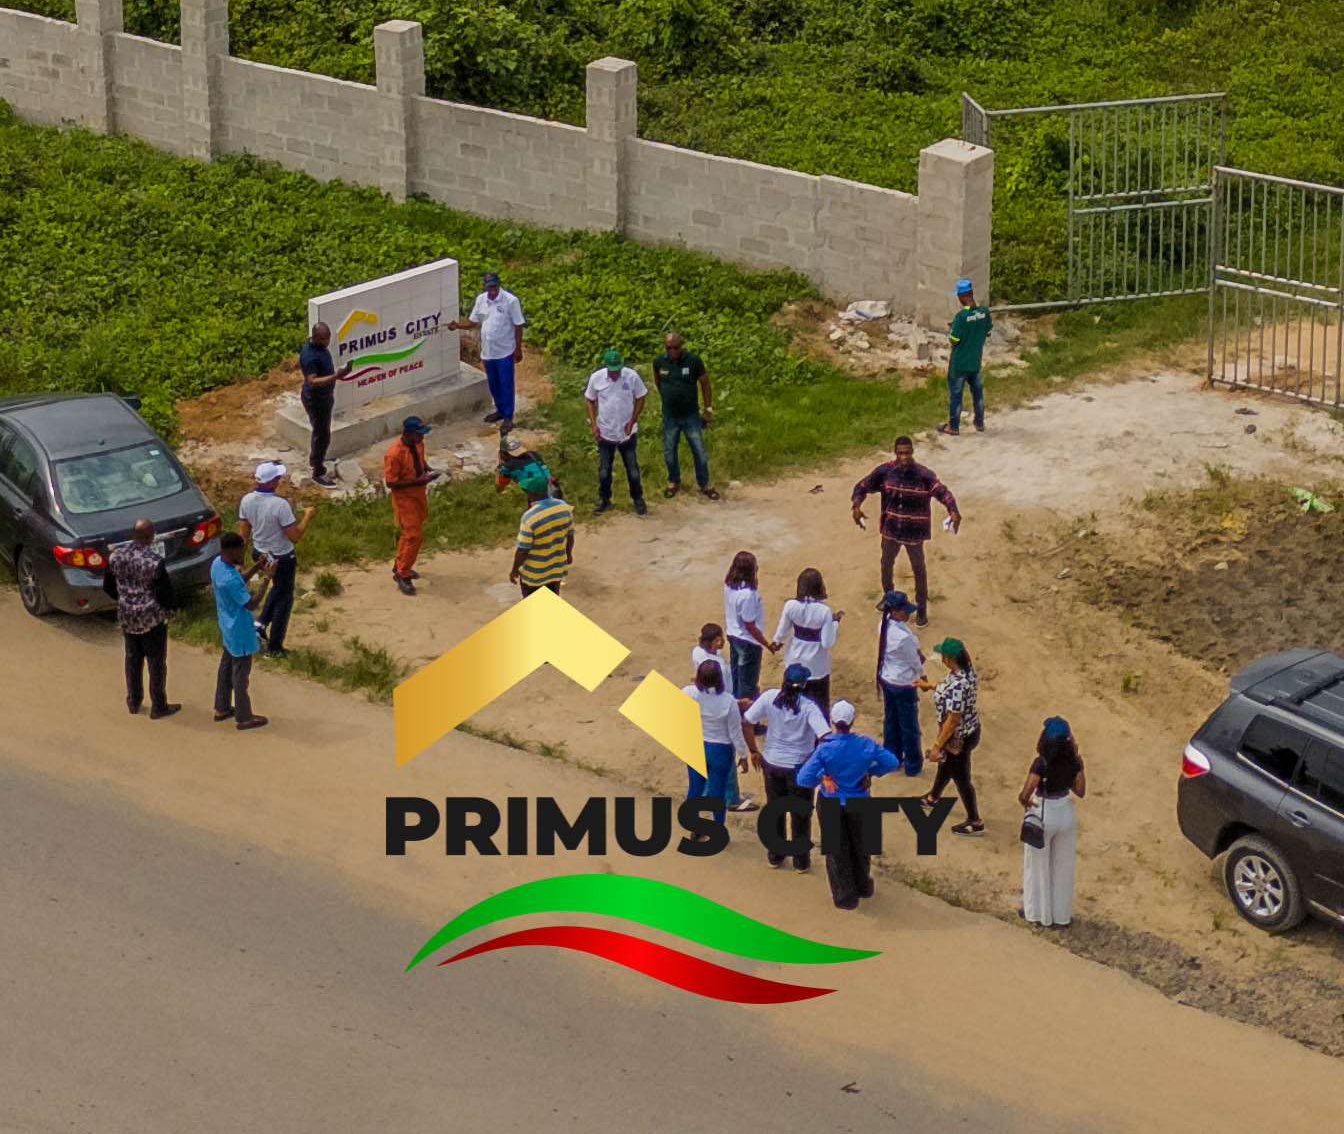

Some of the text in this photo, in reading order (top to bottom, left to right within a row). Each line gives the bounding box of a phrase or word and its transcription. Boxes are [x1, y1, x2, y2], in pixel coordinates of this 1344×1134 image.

[339, 312, 441, 356] PRIMUS CITY
[388, 368, 398, 378] OF
